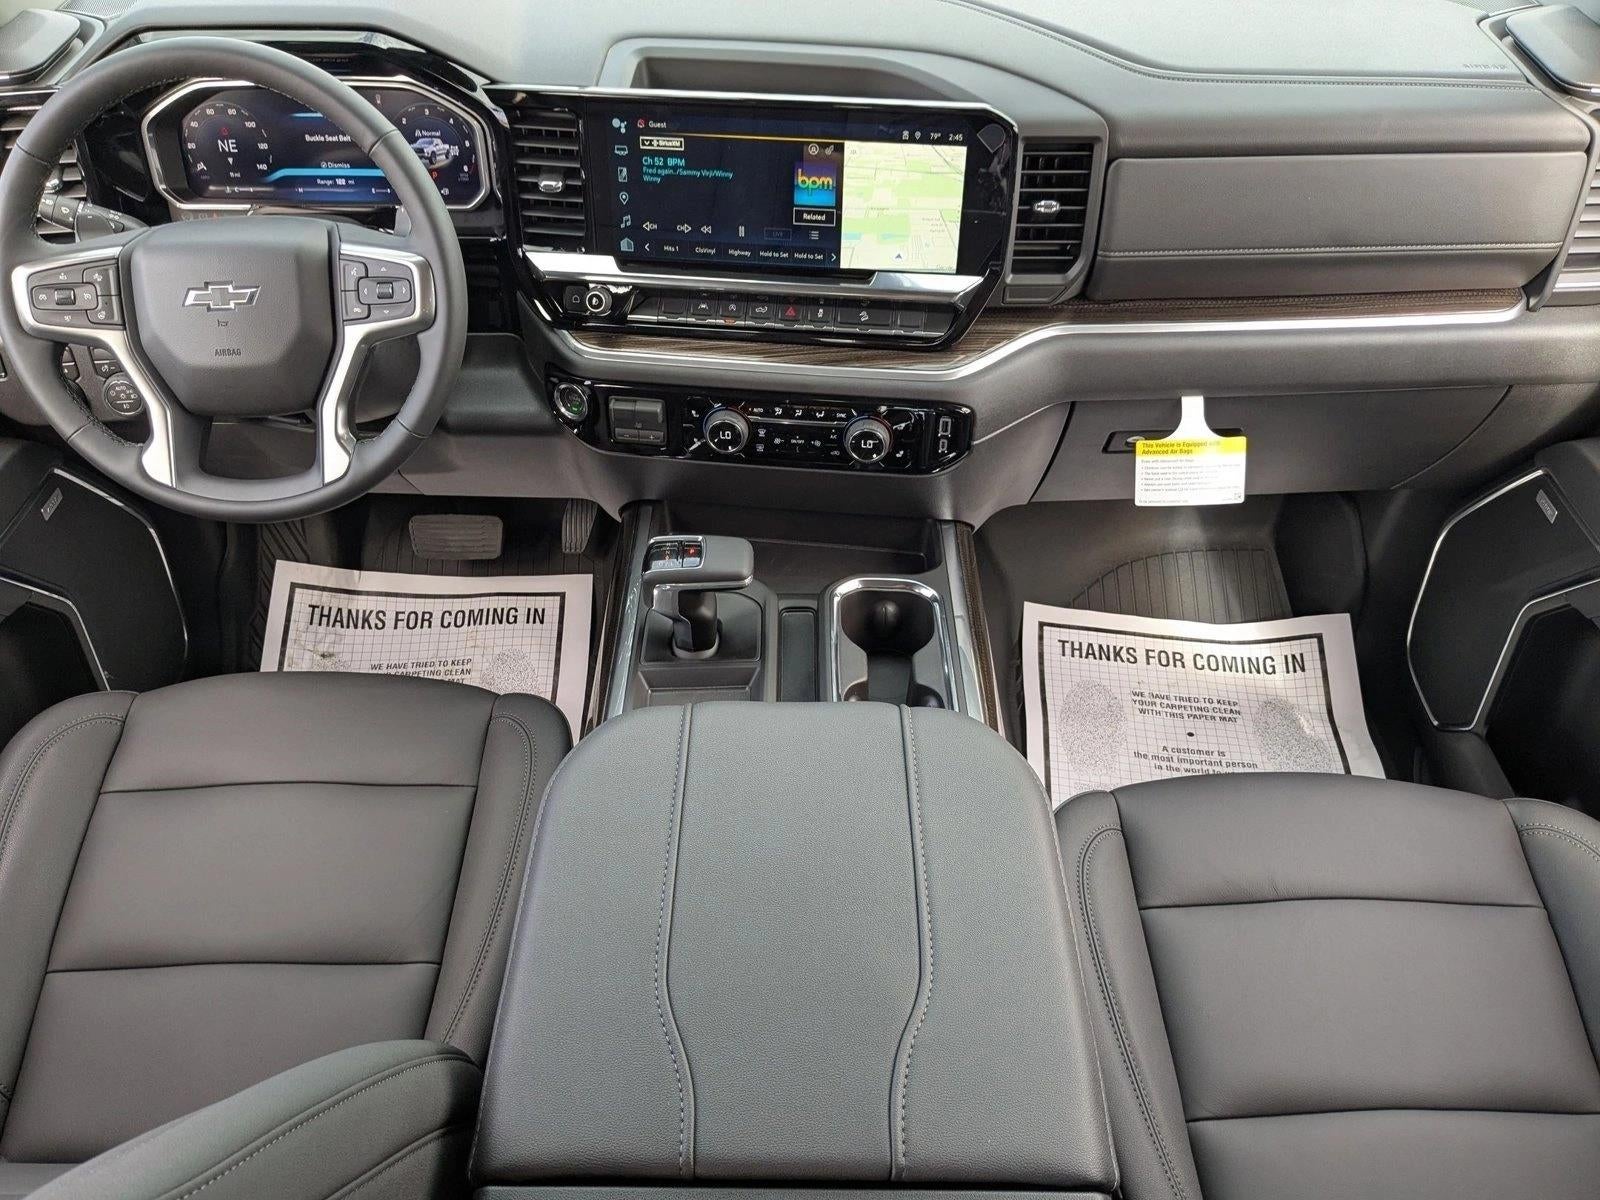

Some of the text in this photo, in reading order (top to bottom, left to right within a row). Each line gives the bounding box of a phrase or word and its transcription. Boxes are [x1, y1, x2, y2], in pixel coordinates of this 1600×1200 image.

[305, 134, 324, 142] Buckle
[218, 140, 238, 152] NE
[642, 157, 685, 166] Ch 52 BPM
[797, 168, 833, 197] bpm
[728, 249, 751, 257] Highway
[215, 348, 241, 356] AIRBAG
[308, 604, 546, 630] THANKS FOR COMING IN
[1058, 639, 1305, 674] THANKS FOR COMING IN
[411, 660, 435, 668] TRIED
[451, 658, 472, 666] KEEP
[1148, 692, 1170, 701] HAVE
[1174, 695, 1200, 703] TRIED
[1217, 699, 1238, 707] KEEP
[1132, 699, 1241, 716] YOUR CARPETING CLEAN
[1138, 708, 1161, 716] WITH
[1164, 711, 1184, 719] THIS
[1187, 713, 1216, 721] PAPER
[1171, 747, 1214, 756] customer
[1134, 752, 1148, 760] the
[1151, 755, 1174, 763] most
[1177, 757, 1222, 768] important
